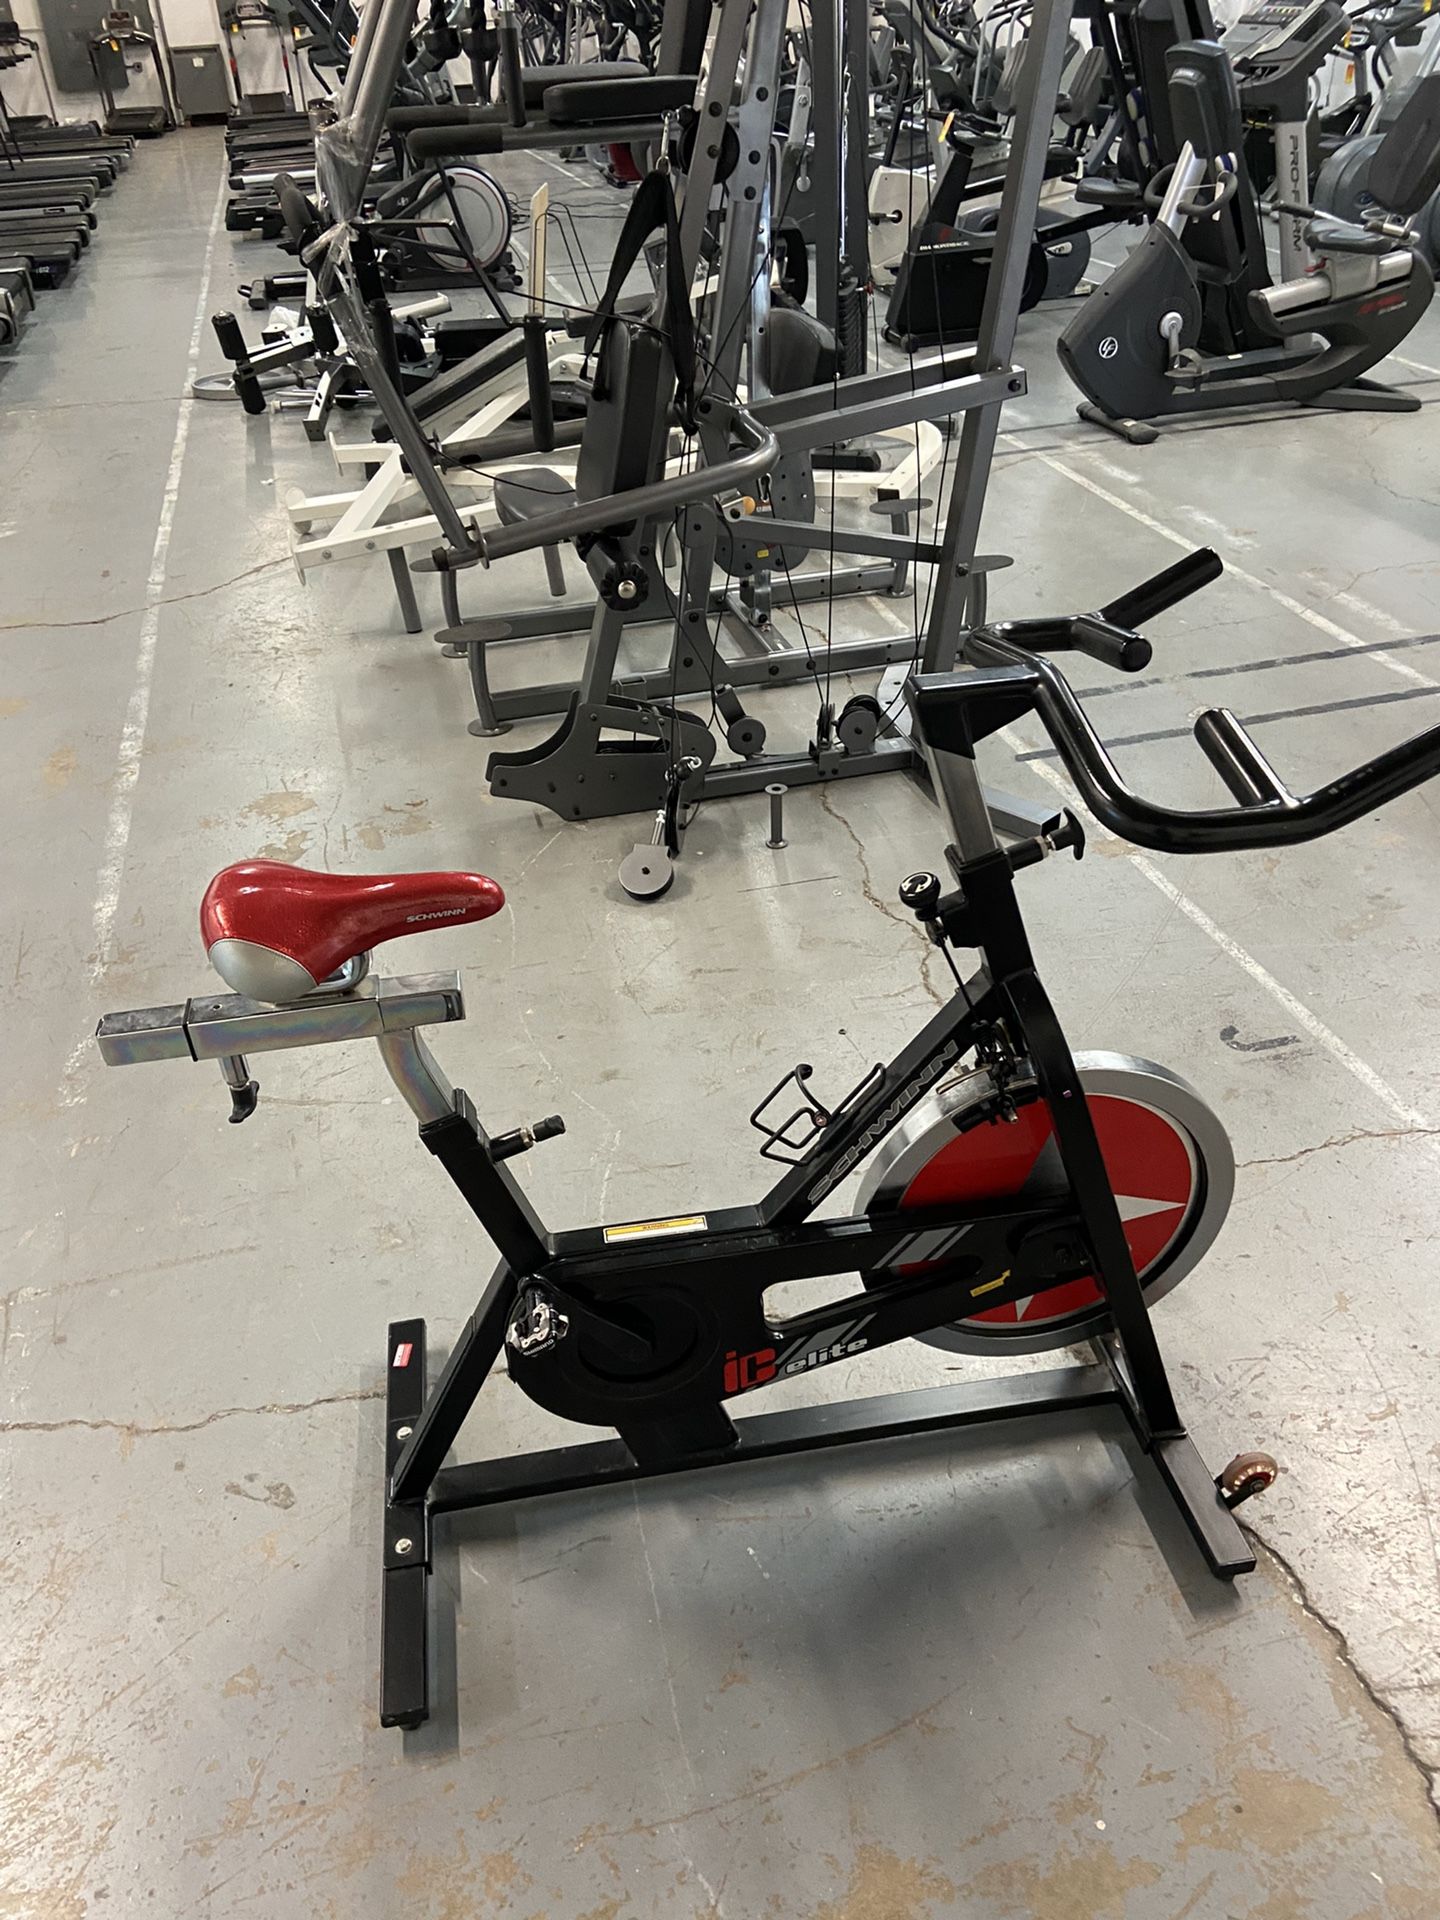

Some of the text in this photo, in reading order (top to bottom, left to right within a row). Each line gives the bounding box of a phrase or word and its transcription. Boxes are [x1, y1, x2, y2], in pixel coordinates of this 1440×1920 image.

[1289, 134, 1302, 252] PRO-FRM
[406, 907, 466, 923] SCHWINN
[807, 1039, 959, 1205] SCHWINN
[785, 1338, 868, 1374] elite
